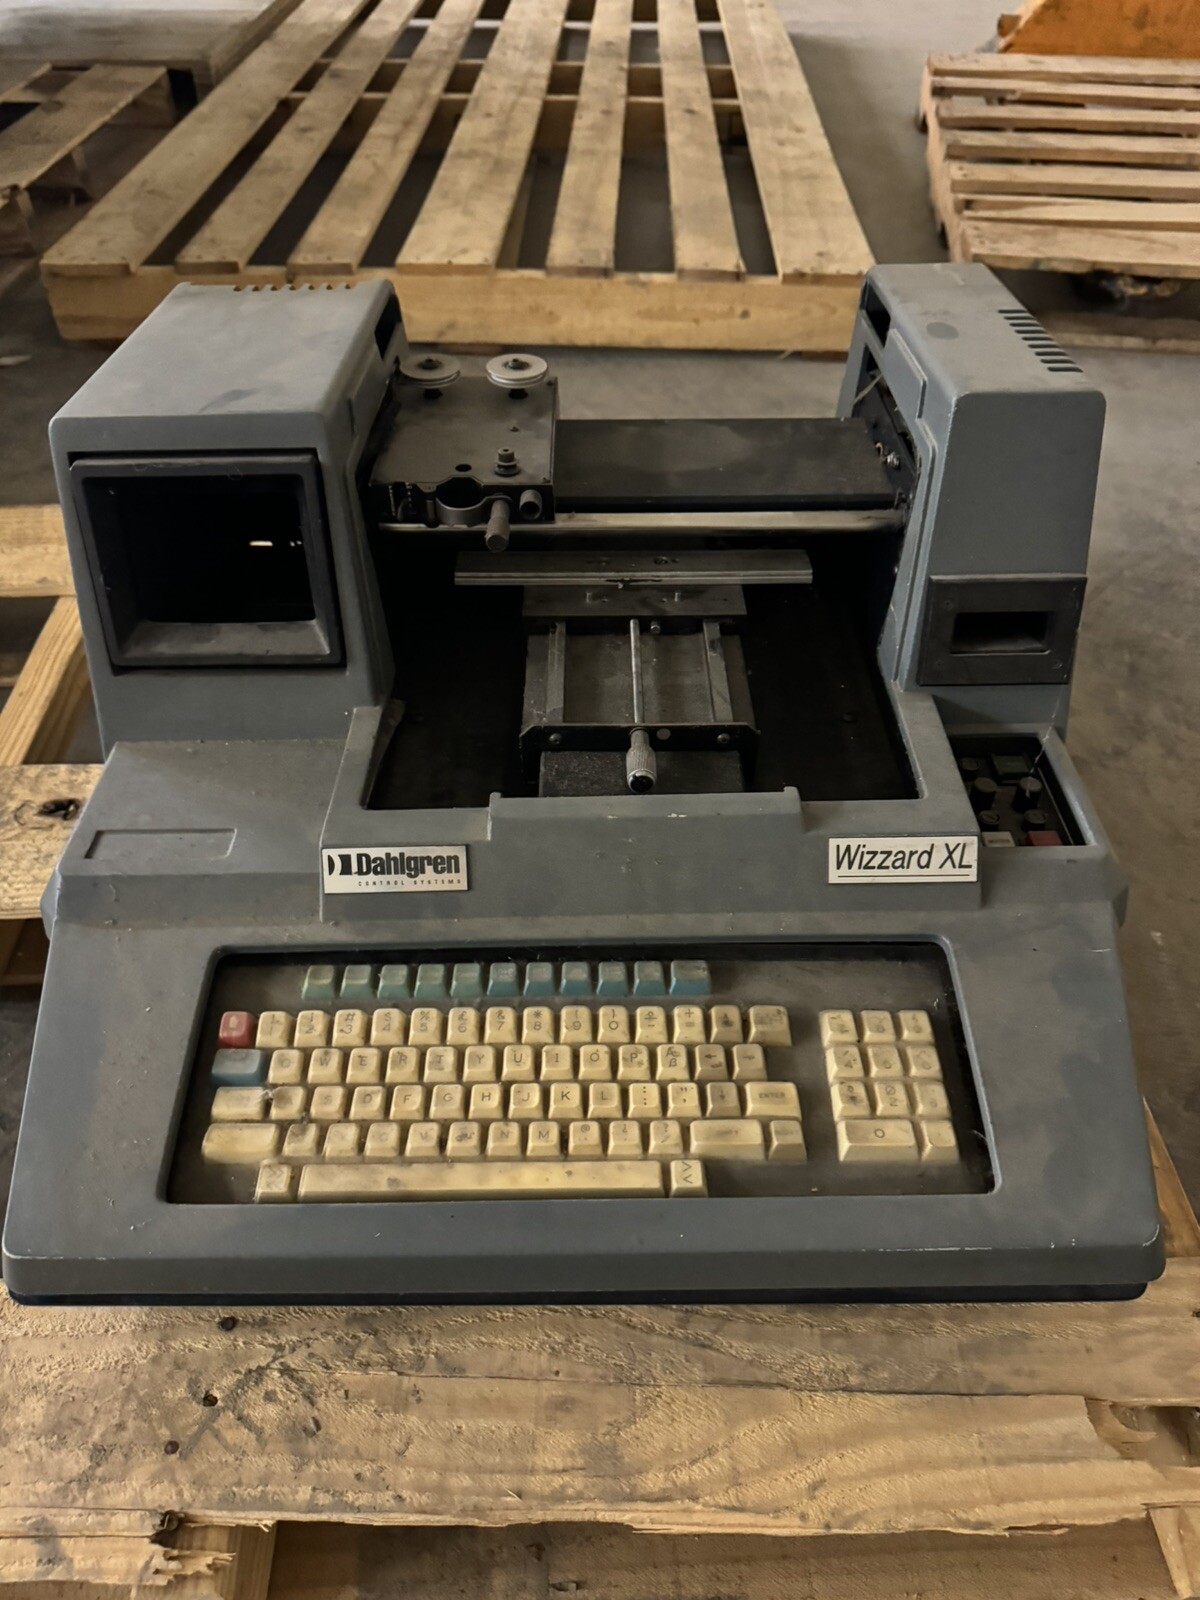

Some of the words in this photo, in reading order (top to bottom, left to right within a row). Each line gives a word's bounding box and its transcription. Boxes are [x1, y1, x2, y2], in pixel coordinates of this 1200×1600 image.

[356, 852, 460, 878] Dahlgren
[836, 843, 934, 870] Wizzard
[938, 842, 972, 869] XL
